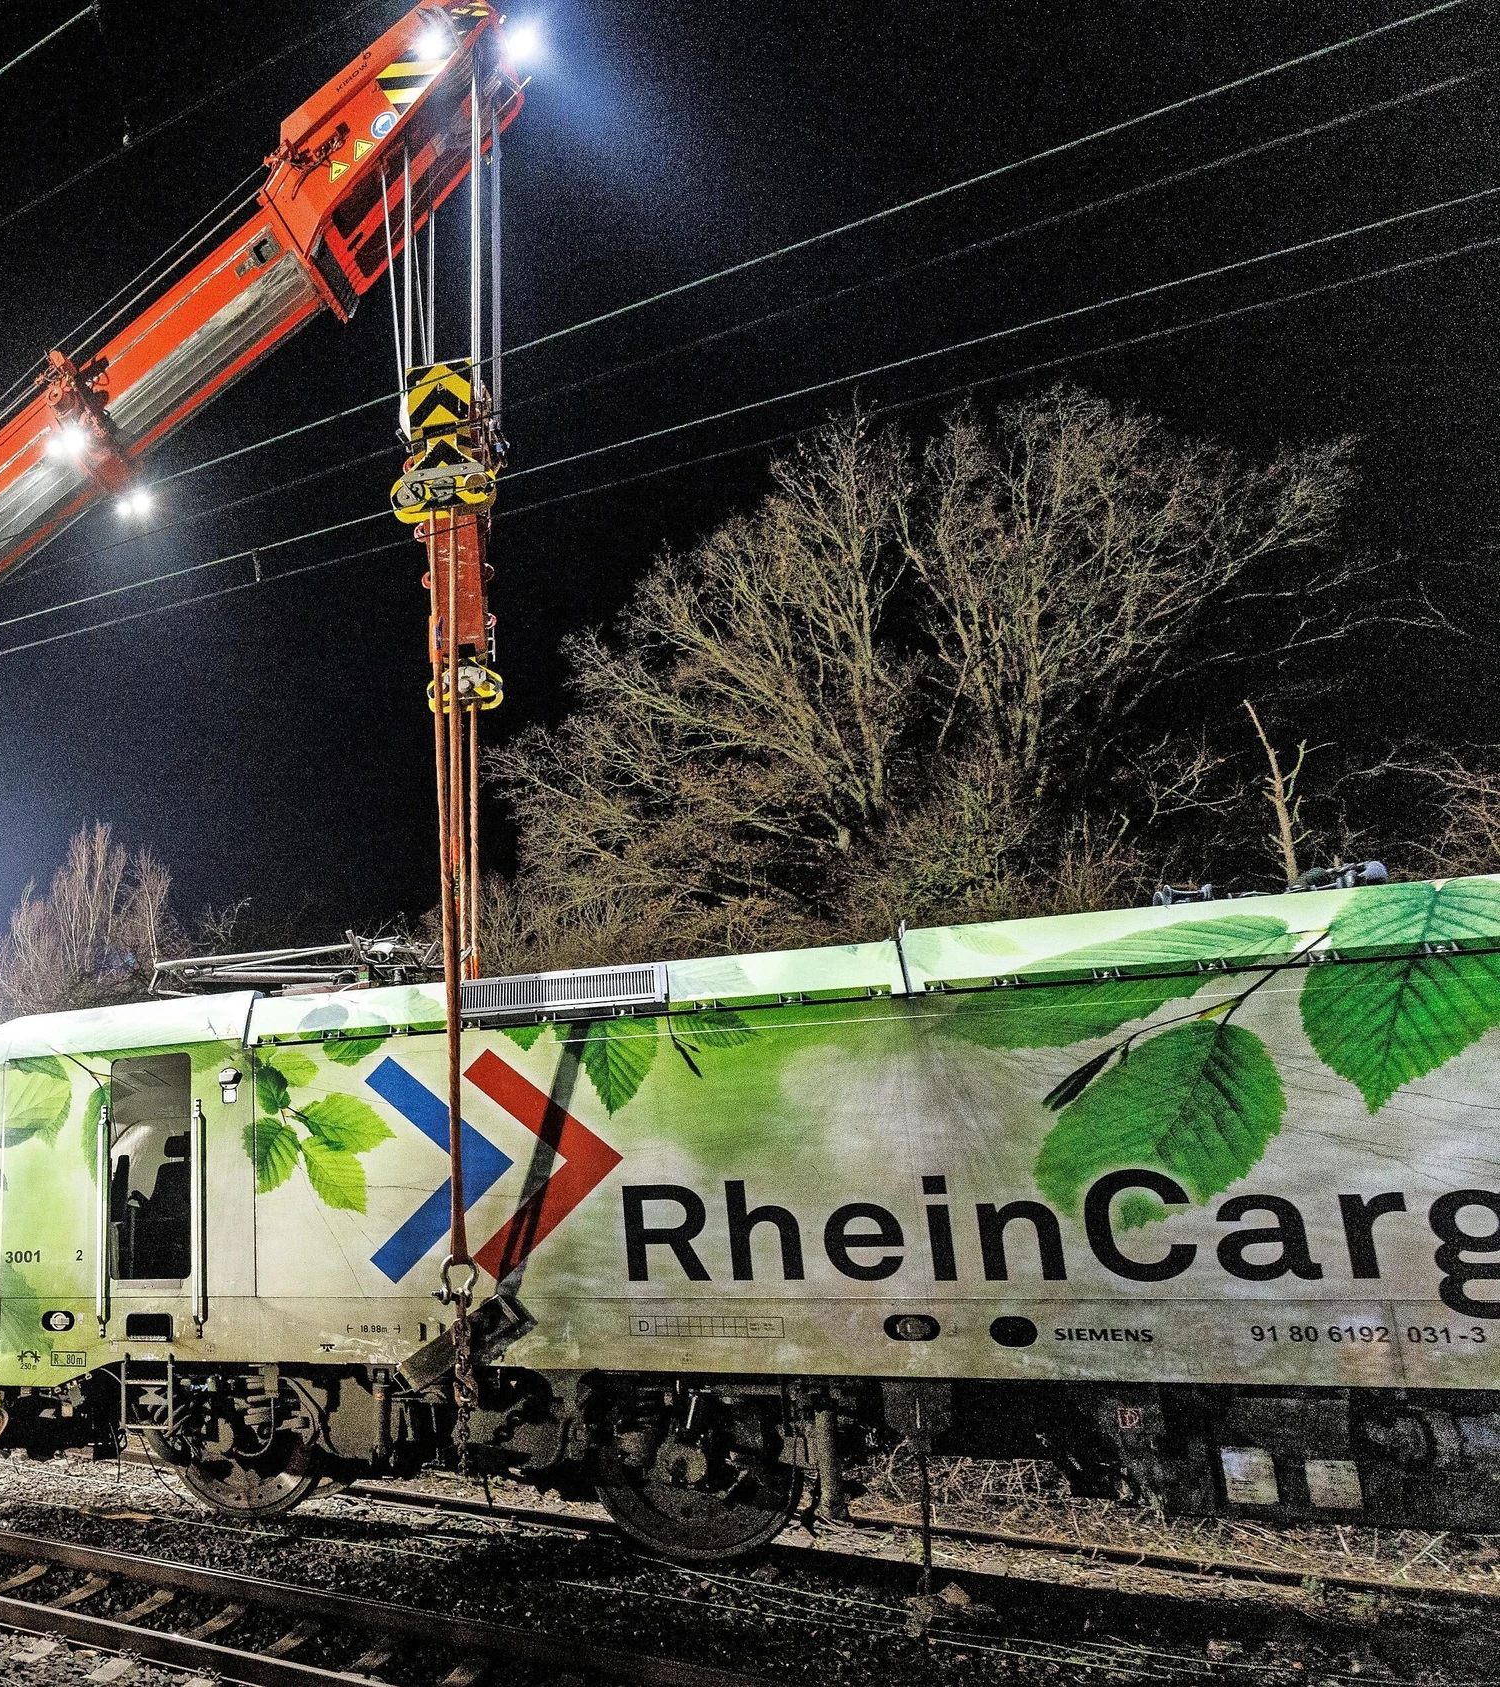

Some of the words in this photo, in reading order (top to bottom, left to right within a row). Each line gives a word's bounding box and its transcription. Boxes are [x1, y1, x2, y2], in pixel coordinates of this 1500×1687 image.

[5, 1250, 41, 1263] 3001
[76, 1249, 83, 1261] 2
[638, 1320, 650, 1332] D
[1054, 1327, 1154, 1343] SIEMENS
[1250, 1325, 1278, 1342] 91
[1289, 1325, 1319, 1343] 80
[1327, 1326, 1390, 1343] 6192
[53, 1353, 59, 1365] R
